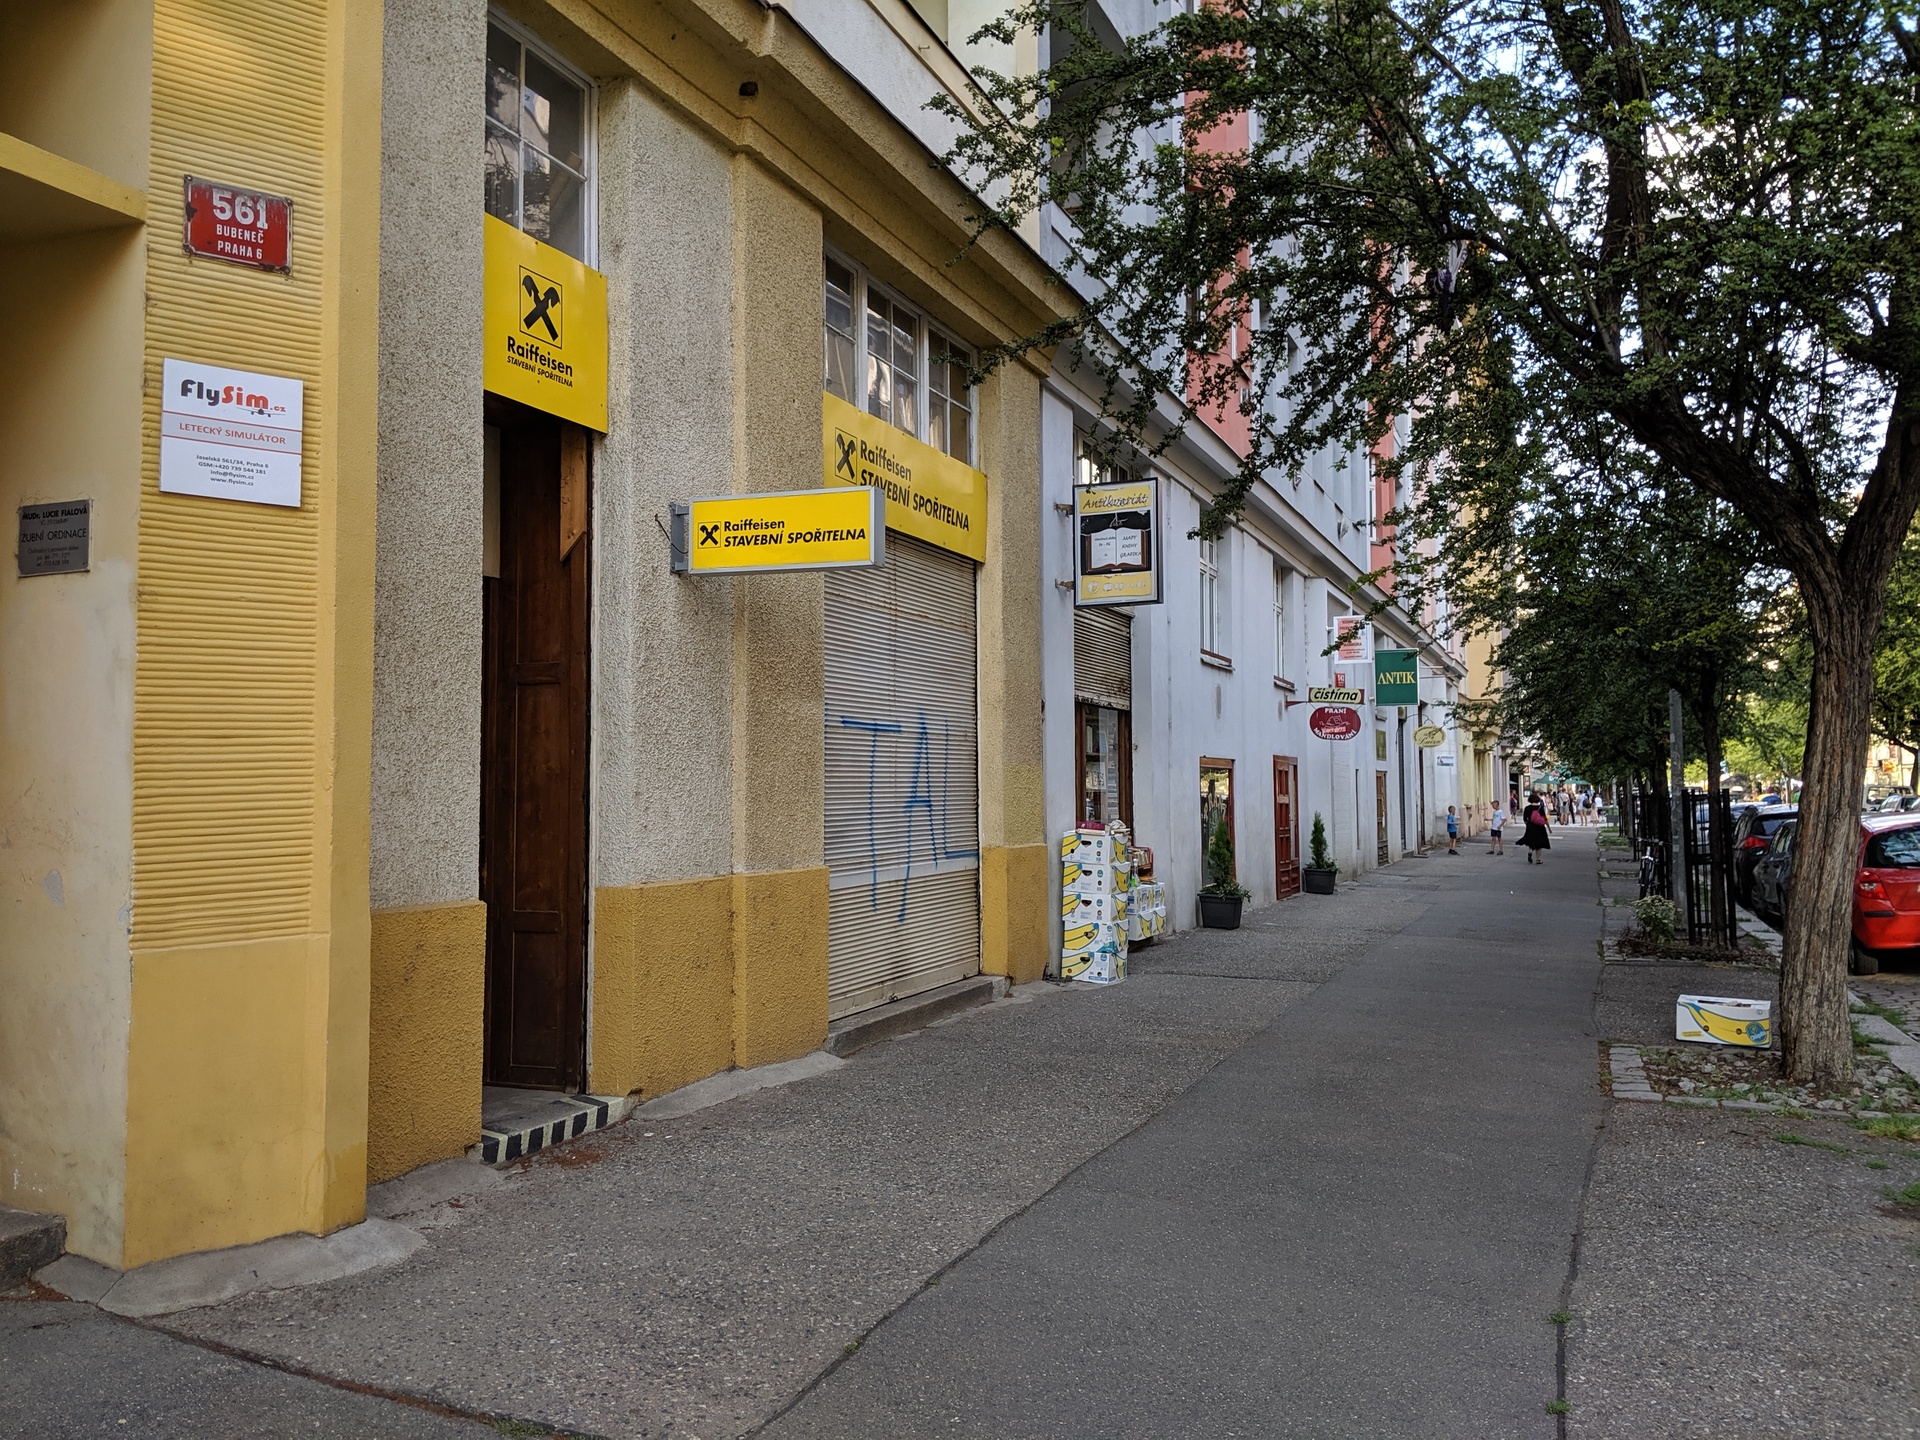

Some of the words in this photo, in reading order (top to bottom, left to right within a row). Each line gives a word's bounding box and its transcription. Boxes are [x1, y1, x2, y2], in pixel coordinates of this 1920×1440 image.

[212, 188, 268, 230] 561
[216, 224, 264, 244] BUBENEČ
[217, 240, 253, 258] PRAHA
[256, 248, 263, 260] 6
[507, 335, 573, 378] Raiffeisen
[506, 355, 536, 374] STAVEBNÍ
[537, 367, 573, 388] SPOŘITELNA
[179, 422, 222, 436] LETECKÝ
[225, 429, 286, 445] SIMULÁTOR
[196, 454, 221, 462] Jaselská
[860, 440, 912, 482] Raiffeisen
[210, 477, 254, 487] www.flysim.cz
[860, 468, 910, 508] STAVEBNÍ
[912, 490, 970, 532] SPOŘITELNA
[22, 512, 40, 520] MUDr.
[42, 510, 59, 518] LUCIE
[61, 504, 88, 517] FIALOVÁ
[723, 518, 785, 532] Raiffeisen
[21, 530, 45, 543] ZUBNÍ
[47, 528, 87, 541] ORDINACE
[723, 530, 784, 547] STAVEBNÍ
[787, 528, 866, 545] SPOŘITELNA
[1377, 671, 1417, 685] ANTIK
[1313, 687, 1359, 701] čistírna
[1313, 727, 1357, 740] MANDLOVÁNÍ
